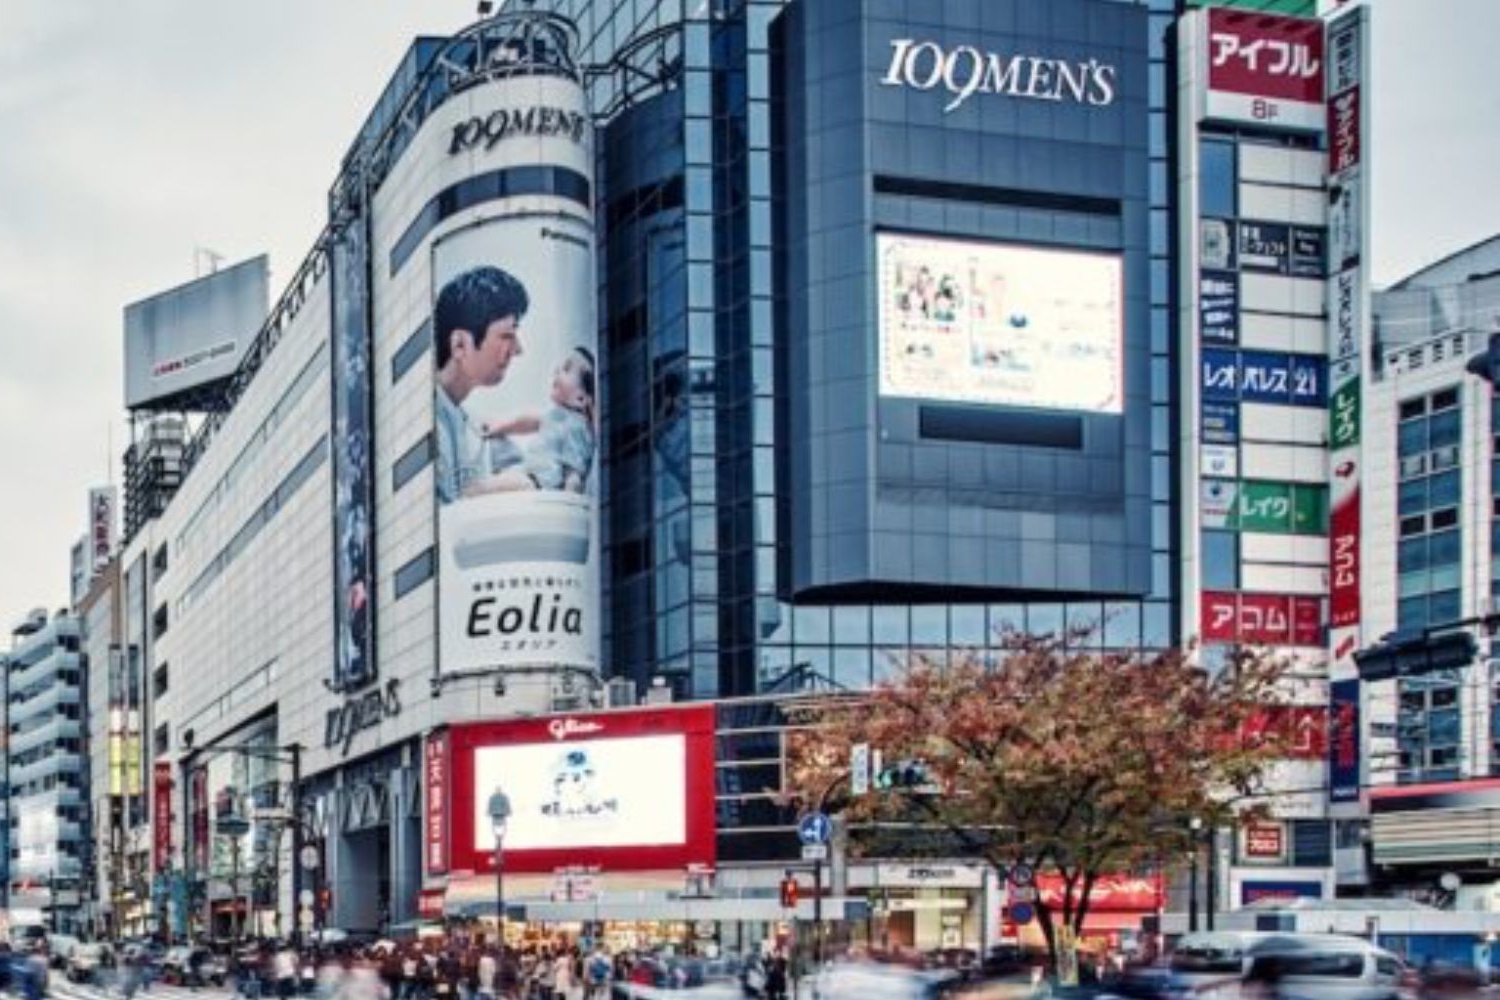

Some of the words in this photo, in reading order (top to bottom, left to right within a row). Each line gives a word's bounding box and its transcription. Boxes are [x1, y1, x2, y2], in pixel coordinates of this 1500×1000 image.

[1211, 32, 1320, 79] アイフル
[1240, 496, 1289, 518] レイク
[467, 593, 582, 638] Eolia
[1211, 605, 1287, 632] アコム
